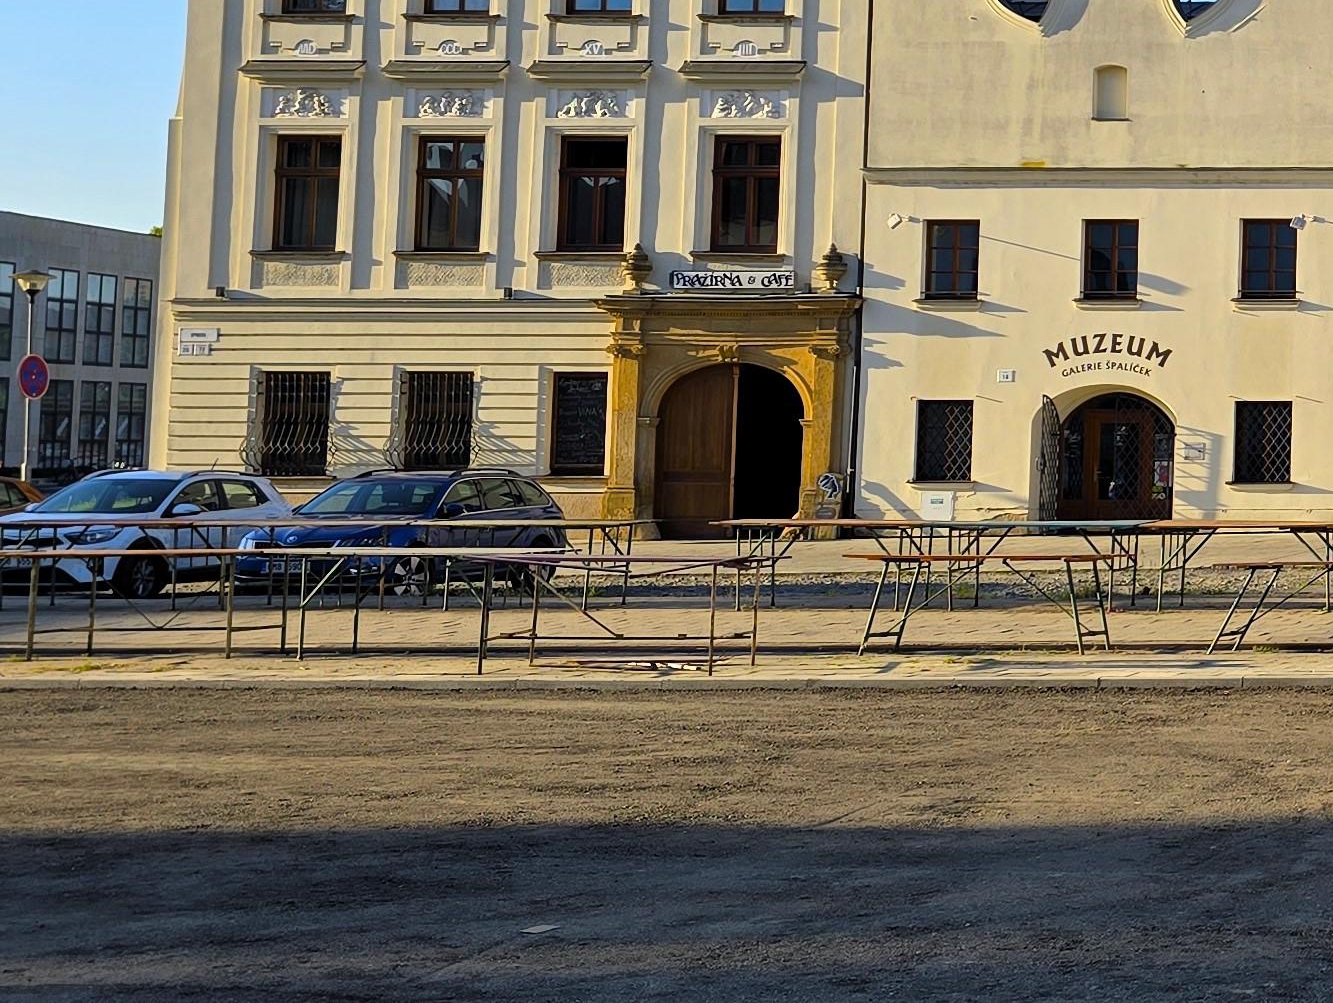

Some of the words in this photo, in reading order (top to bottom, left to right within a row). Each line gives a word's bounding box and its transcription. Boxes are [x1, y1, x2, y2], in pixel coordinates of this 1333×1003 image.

[1042, 333, 1173, 368] MUZEUM
[1061, 361, 1103, 378] GALERIE
[1105, 359, 1152, 378] ŠPALÍČEK
